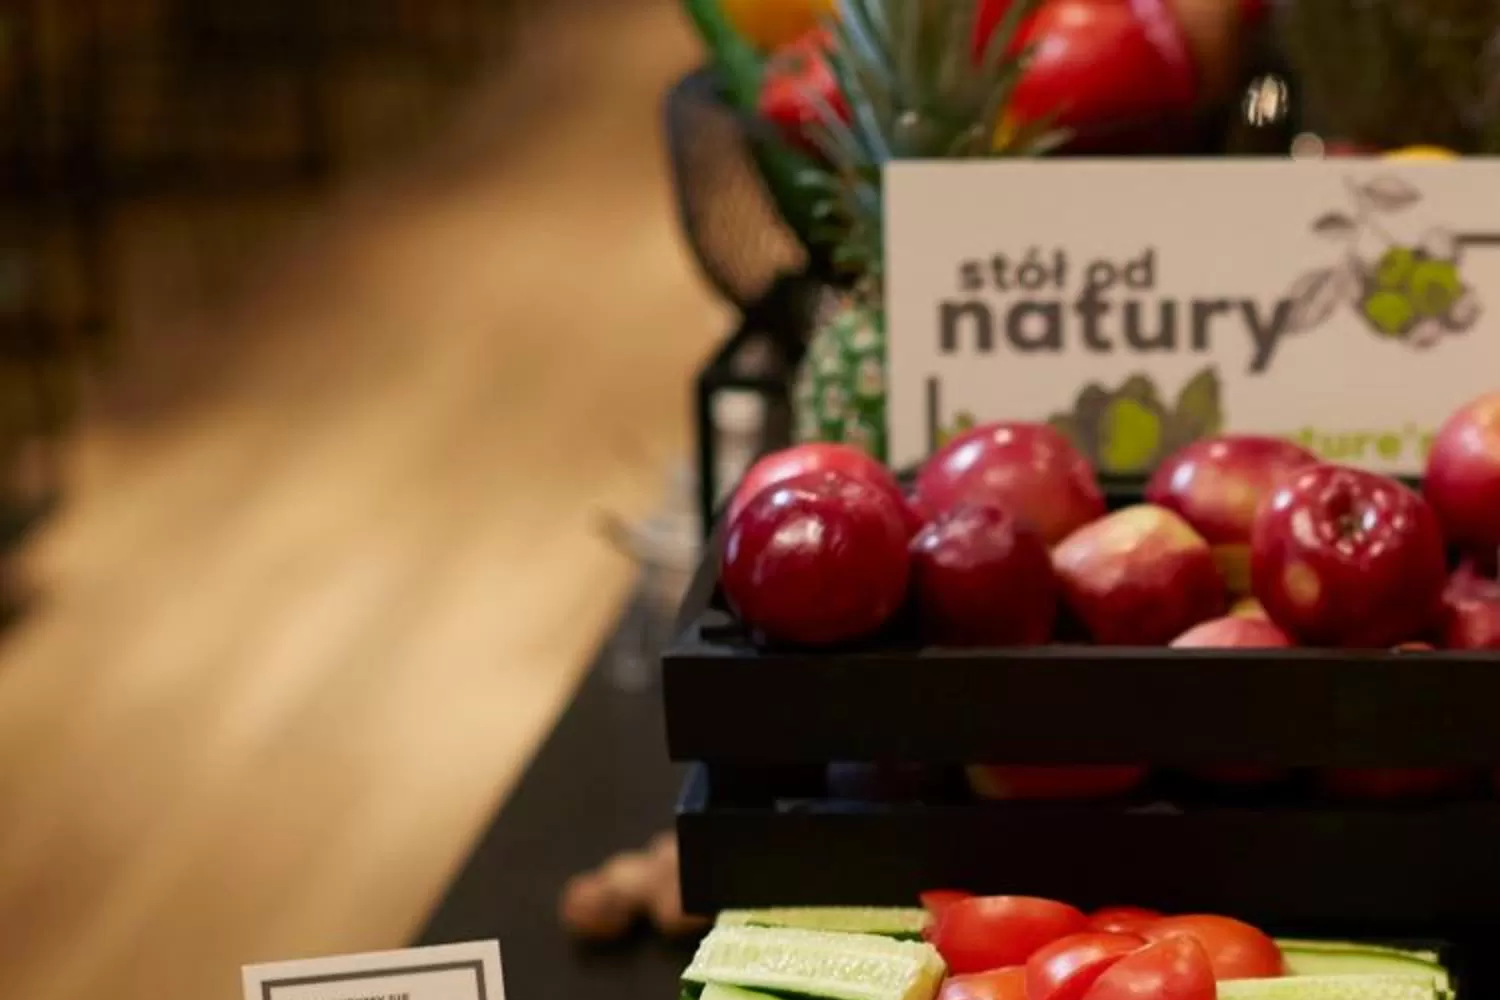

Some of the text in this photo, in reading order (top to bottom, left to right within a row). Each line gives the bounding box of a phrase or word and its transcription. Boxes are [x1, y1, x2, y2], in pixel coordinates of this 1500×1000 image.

[958, 247, 1156, 291] stół od
[939, 288, 1292, 372] natury
